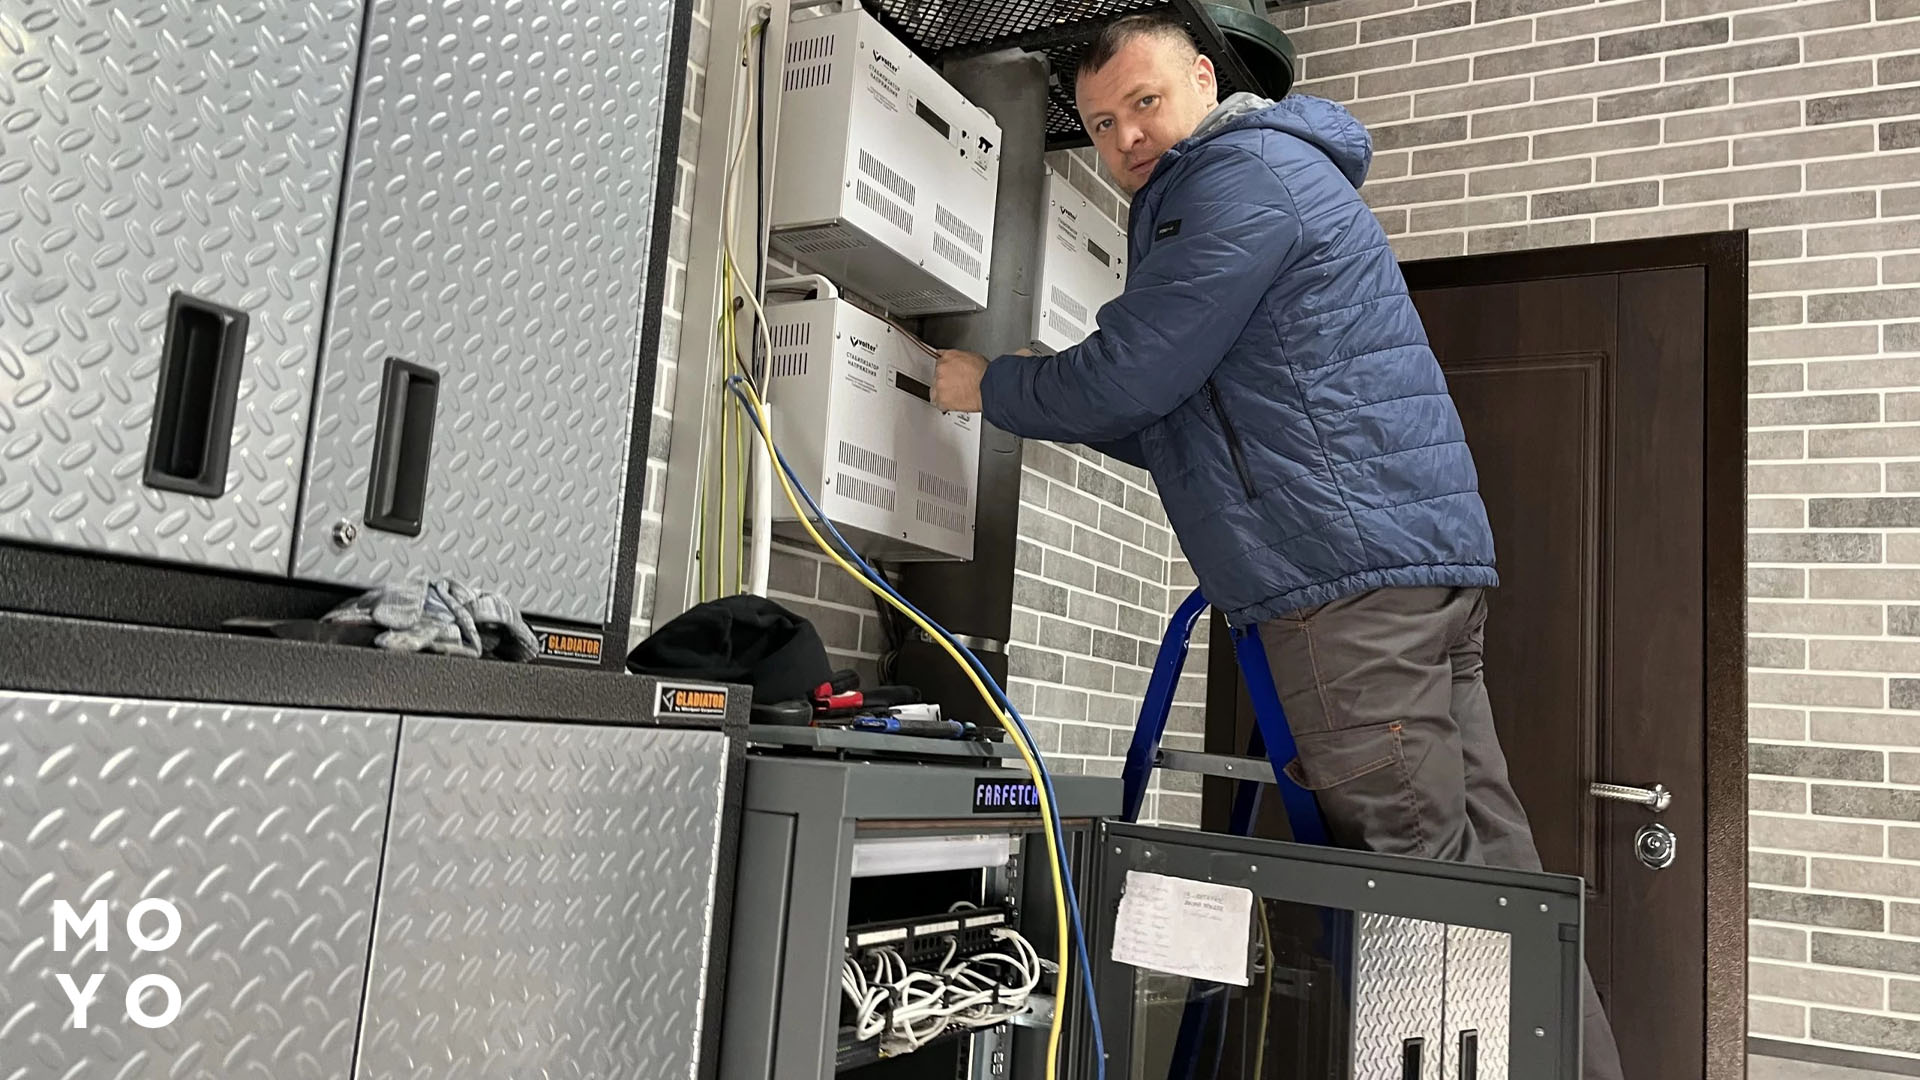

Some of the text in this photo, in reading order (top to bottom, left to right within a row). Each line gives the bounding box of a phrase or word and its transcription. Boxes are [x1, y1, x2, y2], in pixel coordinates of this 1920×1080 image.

[548, 634, 600, 655] GLADIATOR
[676, 691, 725, 708] GLADIATOR
[976, 784, 1039, 806] FARFETCH
